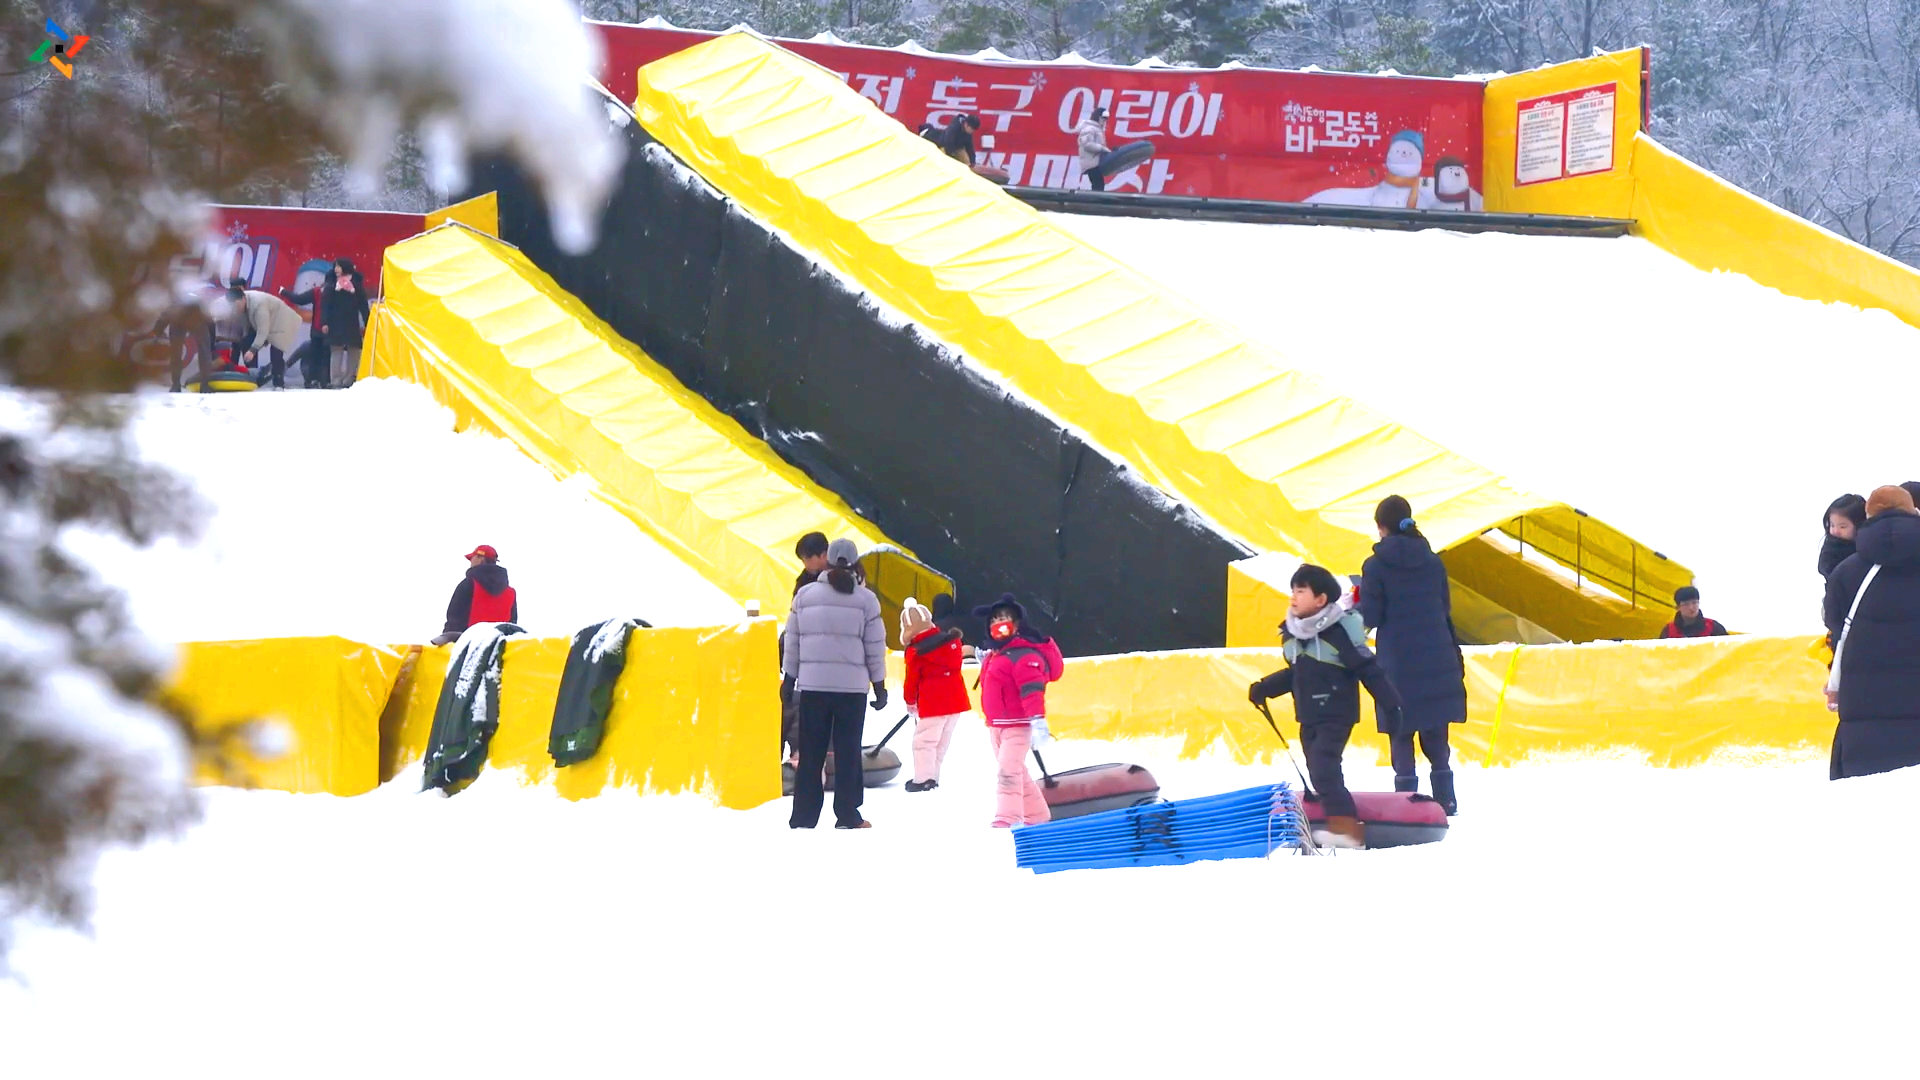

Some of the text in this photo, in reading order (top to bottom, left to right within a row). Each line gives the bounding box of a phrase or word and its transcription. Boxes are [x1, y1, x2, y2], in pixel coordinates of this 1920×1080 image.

[835, 72, 904, 115] 전
[925, 79, 1036, 133] 동구
[1285, 109, 1382, 152] 바로동구
